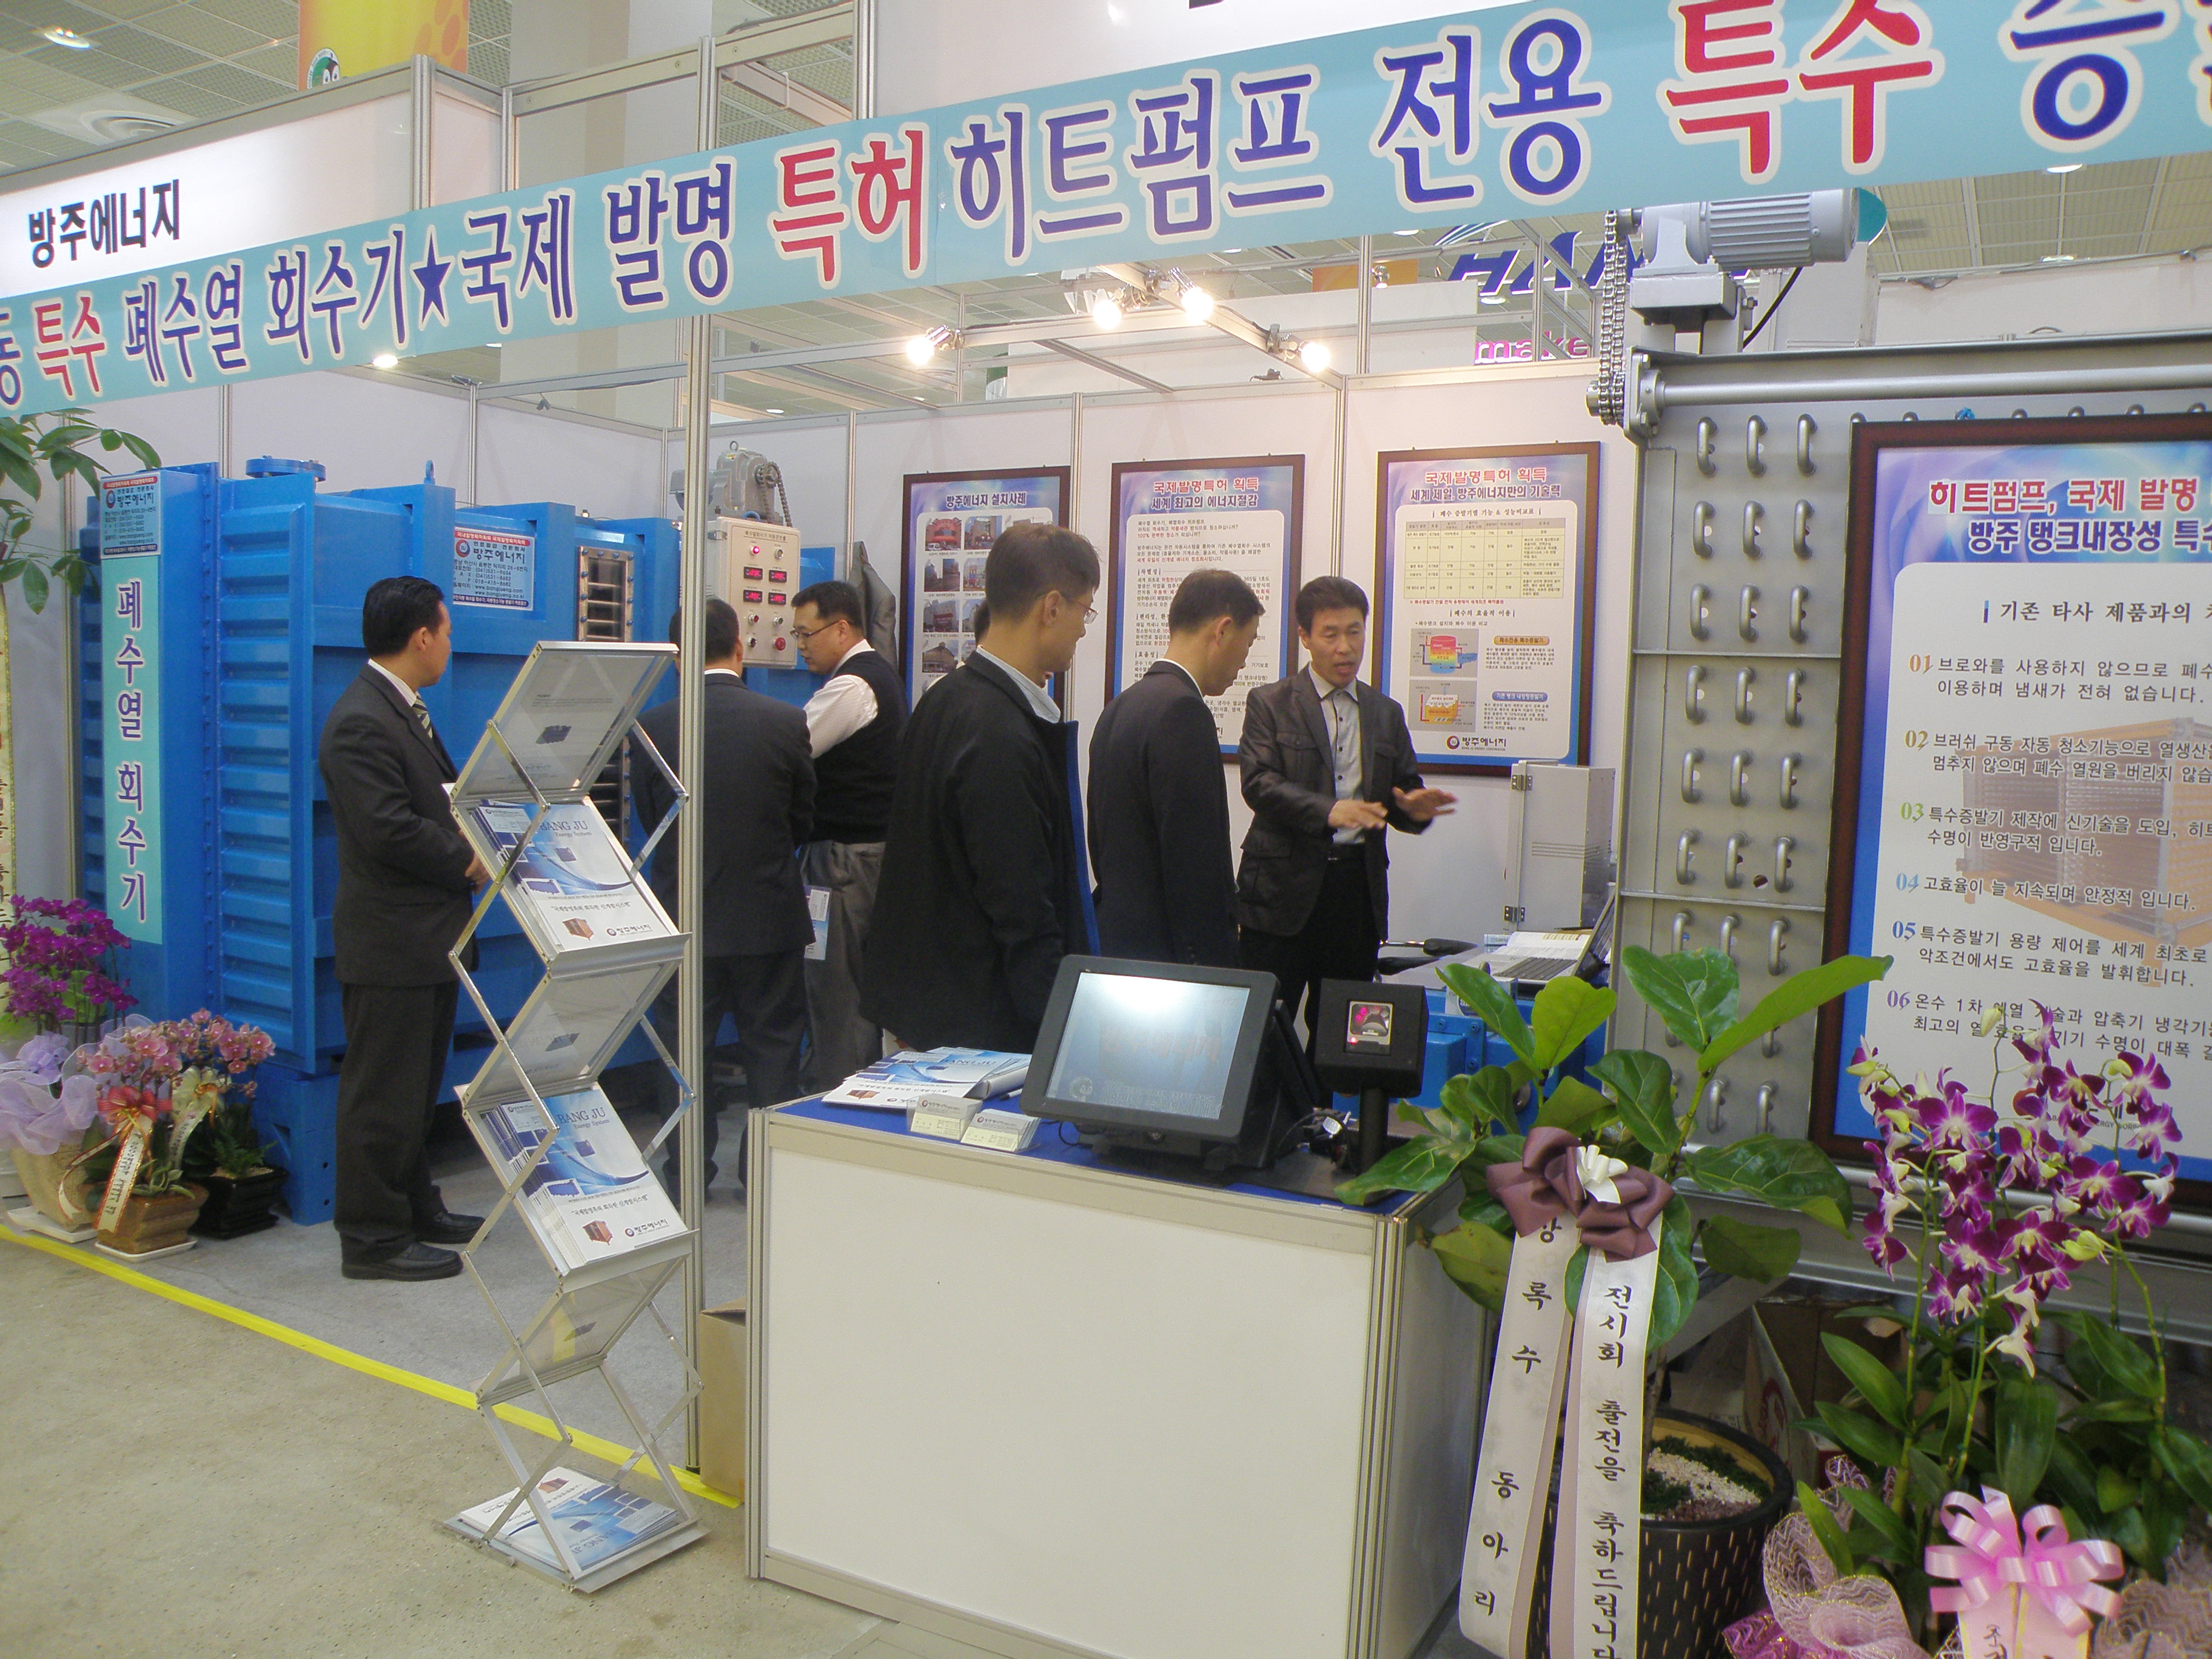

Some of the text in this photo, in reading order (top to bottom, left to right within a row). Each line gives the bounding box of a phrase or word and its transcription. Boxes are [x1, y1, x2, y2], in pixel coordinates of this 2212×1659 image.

[35, 297, 106, 398] 특수
[124, 264, 247, 383] 폐수열
[267, 230, 405, 361] 회수기
[463, 195, 572, 329] 국제
[606, 163, 732, 307] 발명
[773, 130, 923, 284] 특허
[951, 75, 1326, 260] 히트펌프
[1378, 18, 1601, 204] 전용
[1665, 0, 1934, 175] 특수
[28, 179, 180, 269] 방주에너지
[1154, 478, 1259, 494] 국제발명특허 획득
[1426, 468, 1547, 485] 국제발명특허 획득
[946, 492, 1027, 508] 방주에너지 설치사례
[1151, 495, 1258, 510] 세계 최고의 에너지절감
[1410, 484, 1561, 501] 세계 제일, 방주에너지만의 기술력
[1931, 478, 2197, 514] 히트펌프, 국제 발명
[1969, 521, 2020, 552] 방주
[2029, 520, 2161, 552] 탱크내장성
[473, 548, 525, 565] 방주에너지
[2000, 600, 2191, 624] 기존 타사 제품과의
[116, 581, 144, 739] 폐수열
[1908, 654, 1933, 675] 01
[1938, 657, 2005, 675] 브로와를
[2016, 659, 2086, 677] 사용하지
[2097, 660, 2169, 679] 않으므로
[1937, 679, 2204, 703] 이용하며 냄새가 전혀 없습니다.
[1462, 737, 1507, 747] 방주에너지
[1904, 729, 1929, 751] 02
[1933, 733, 1977, 751] 브러쉬
[1984, 734, 2014, 752] 구동
[2020, 736, 2051, 753] 자동
[2059, 737, 2151, 757] 청소기능으로
[1932, 755, 1976, 773] 멈추지
[1983, 757, 2026, 776] 않으며
[2034, 759, 2063, 777] 폐수
[2073, 760, 2118, 779] 열원을
[2127, 764, 2173, 782] 버리지
[573, 820, 588, 831] JU
[1900, 802, 1925, 823] 03
[1929, 806, 2005, 826] 특수증발기
[2011, 811, 2058, 830] 제작에
[2067, 814, 2131, 834] 신기술을
[2139, 817, 2177, 839] 도입,
[117, 763, 146, 922] 회수기
[1926, 830, 2102, 856] 수명이 반영구적 입니다.
[1895, 873, 2197, 911] 04 고효율이 늘 지속되며 안정적 입니다.
[1891, 920, 2208, 964] 05 특수증발기 용량 제어를 세계 최초로
[1919, 948, 2195, 987] 악조건에서도 고효율을 발휘합니다.
[1886, 990, 1911, 1011] 06
[1915, 993, 1946, 1011] 온수
[2094, 1010, 2143, 1030] 압축기
[1913, 1015, 1960, 1035] 최고의
[2095, 1033, 2145, 1054] 수명이
[2157, 1040, 2191, 1059] 대폭
[557, 1107, 606, 1124] BANG JU
[1597, 1284, 1632, 1369] 전시회
[1594, 1399, 1628, 1481] 출전을
